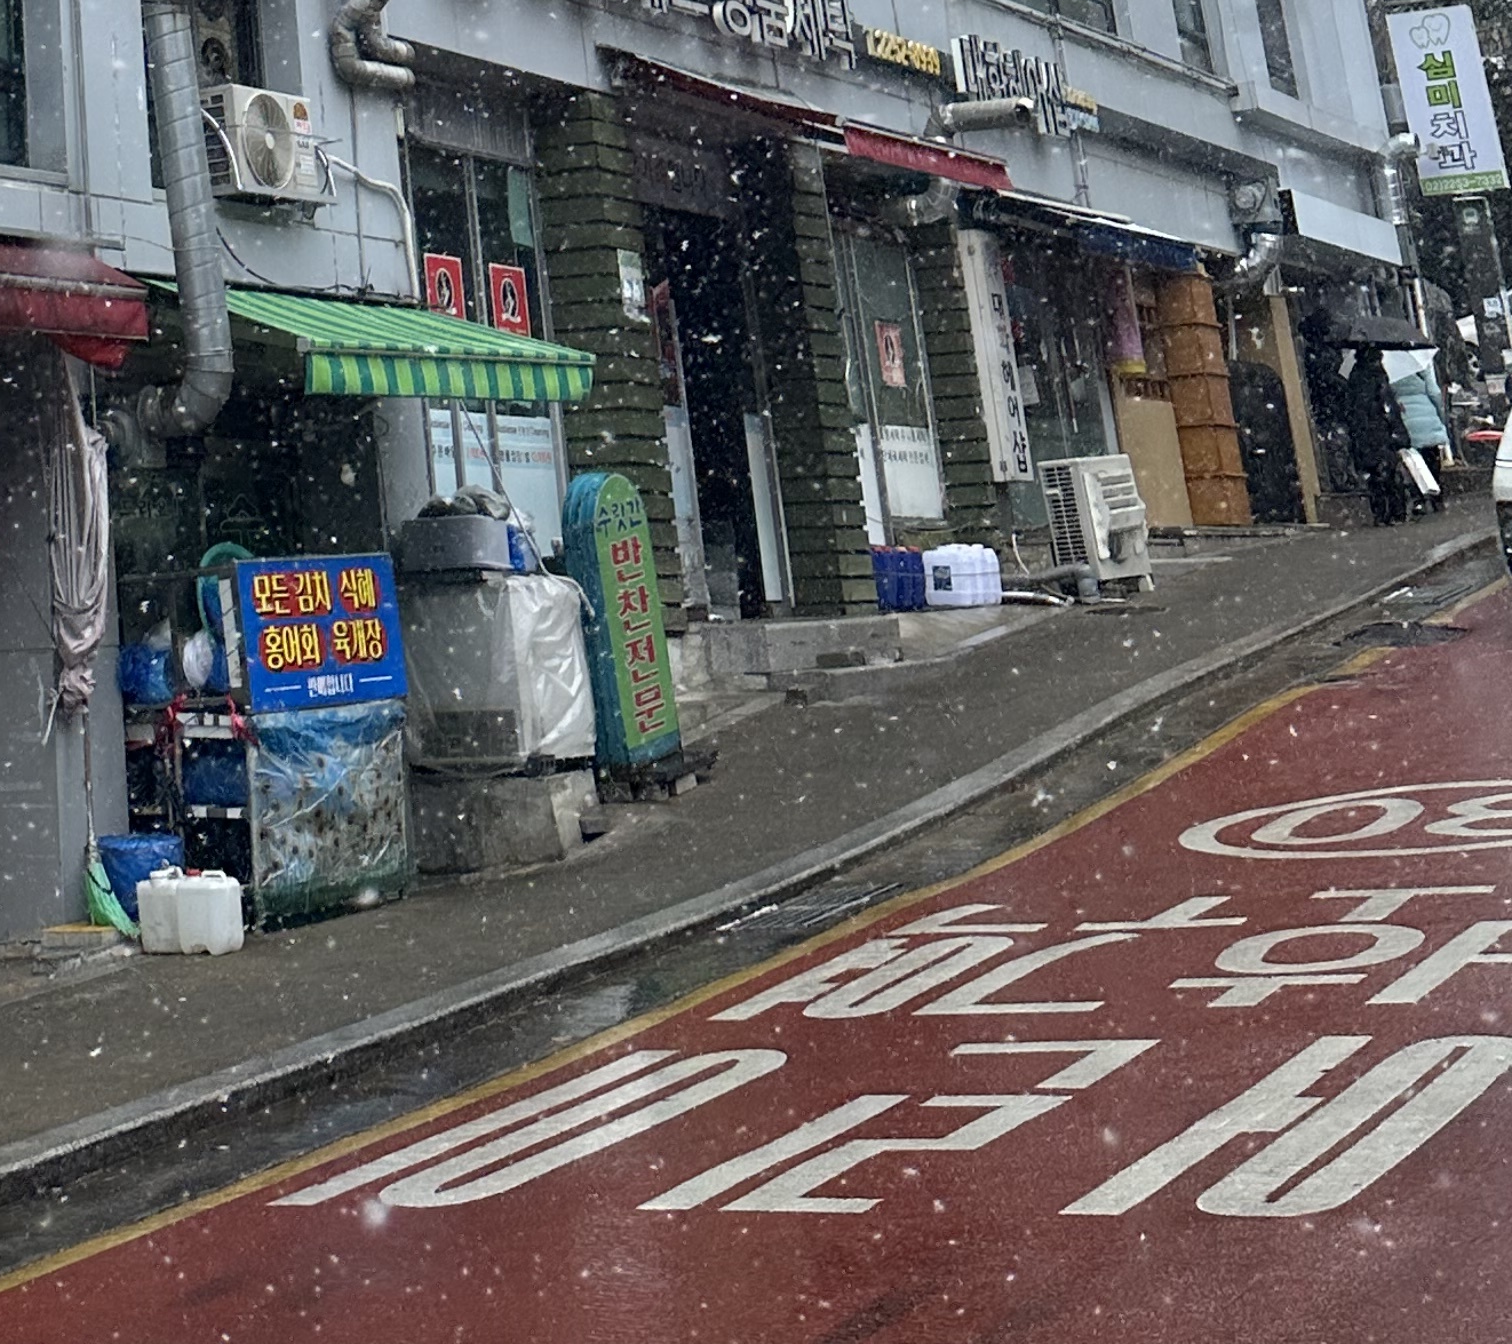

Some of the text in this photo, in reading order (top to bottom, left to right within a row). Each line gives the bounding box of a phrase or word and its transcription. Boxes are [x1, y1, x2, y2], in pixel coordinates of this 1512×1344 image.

[1417, 50, 1477, 170] 심미치과
[253, 568, 376, 614] 모든 김치 식혜
[264, 618, 384, 670] 홍어회 육개장
[610, 535, 665, 734] 반찬전문
[307, 673, 354, 698] 판매합니다
